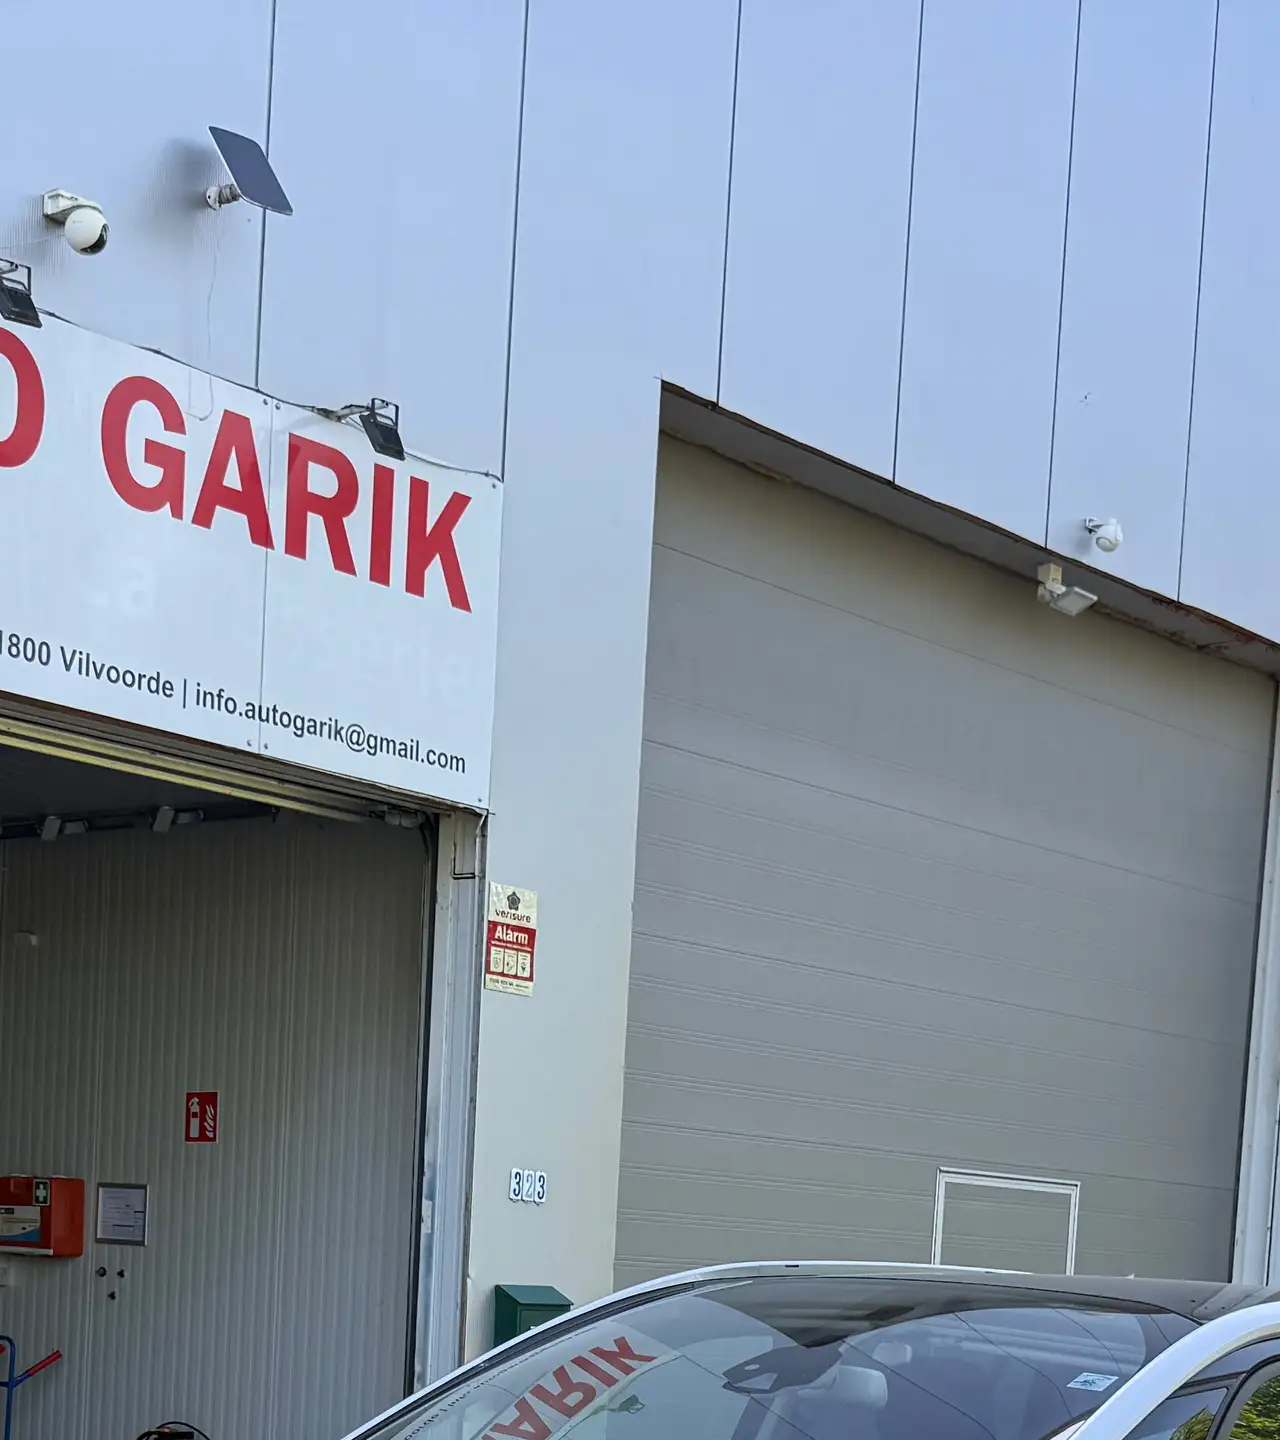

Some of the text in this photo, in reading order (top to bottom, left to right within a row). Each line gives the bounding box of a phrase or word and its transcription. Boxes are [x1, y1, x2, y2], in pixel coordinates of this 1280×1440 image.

[100, 374, 473, 613] GARIK
[60, 645, 175, 699] Vilvoorde
[195, 682, 467, 775] info.autogarik@gmail.com
[494, 925, 529, 945] Alarm
[512, 1171, 546, 1200] 323
